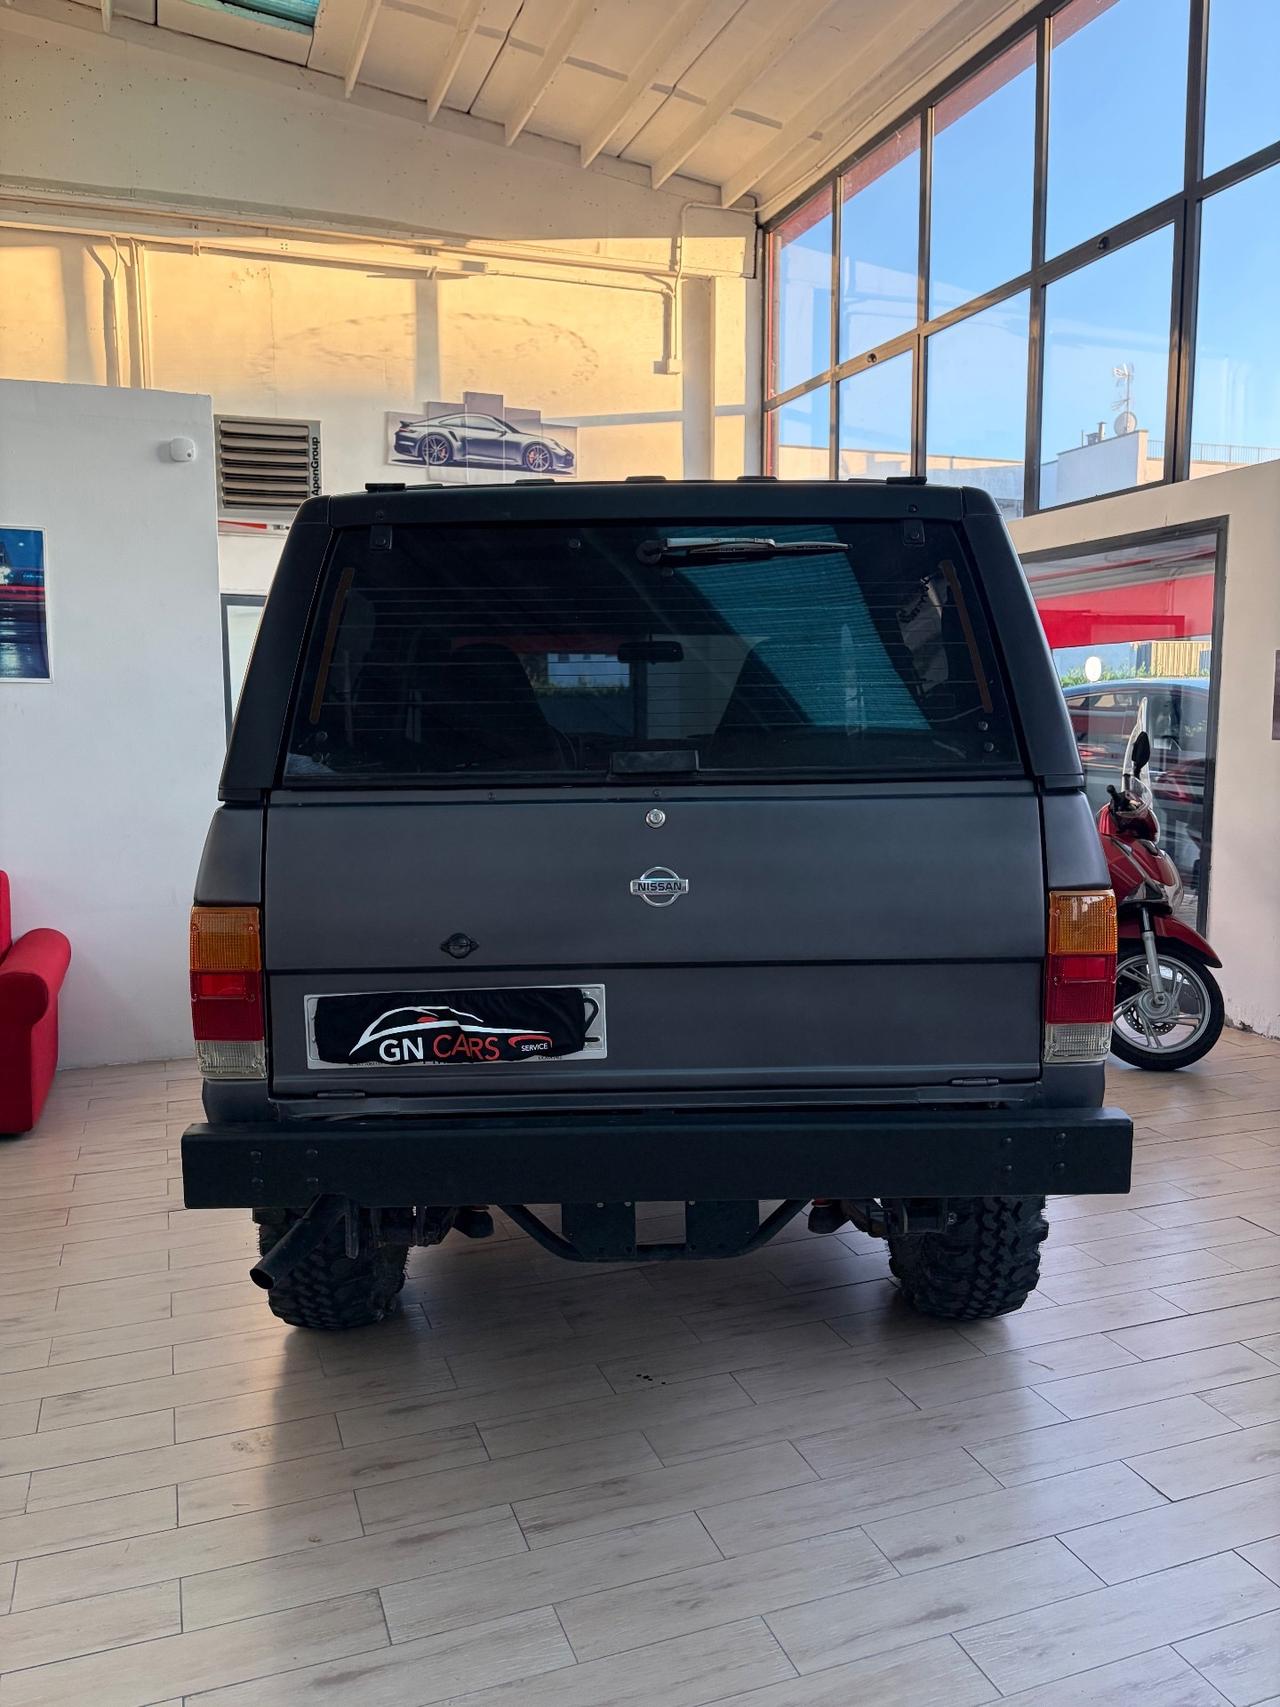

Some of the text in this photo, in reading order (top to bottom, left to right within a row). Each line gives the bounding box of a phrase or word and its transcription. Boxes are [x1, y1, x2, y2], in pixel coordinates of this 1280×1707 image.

[311, 436, 321, 496] ApenGroup
[637, 882, 682, 891] NISSAN
[379, 1033, 500, 1062] GN CARS
[521, 1042, 548, 1051] SERVICE
